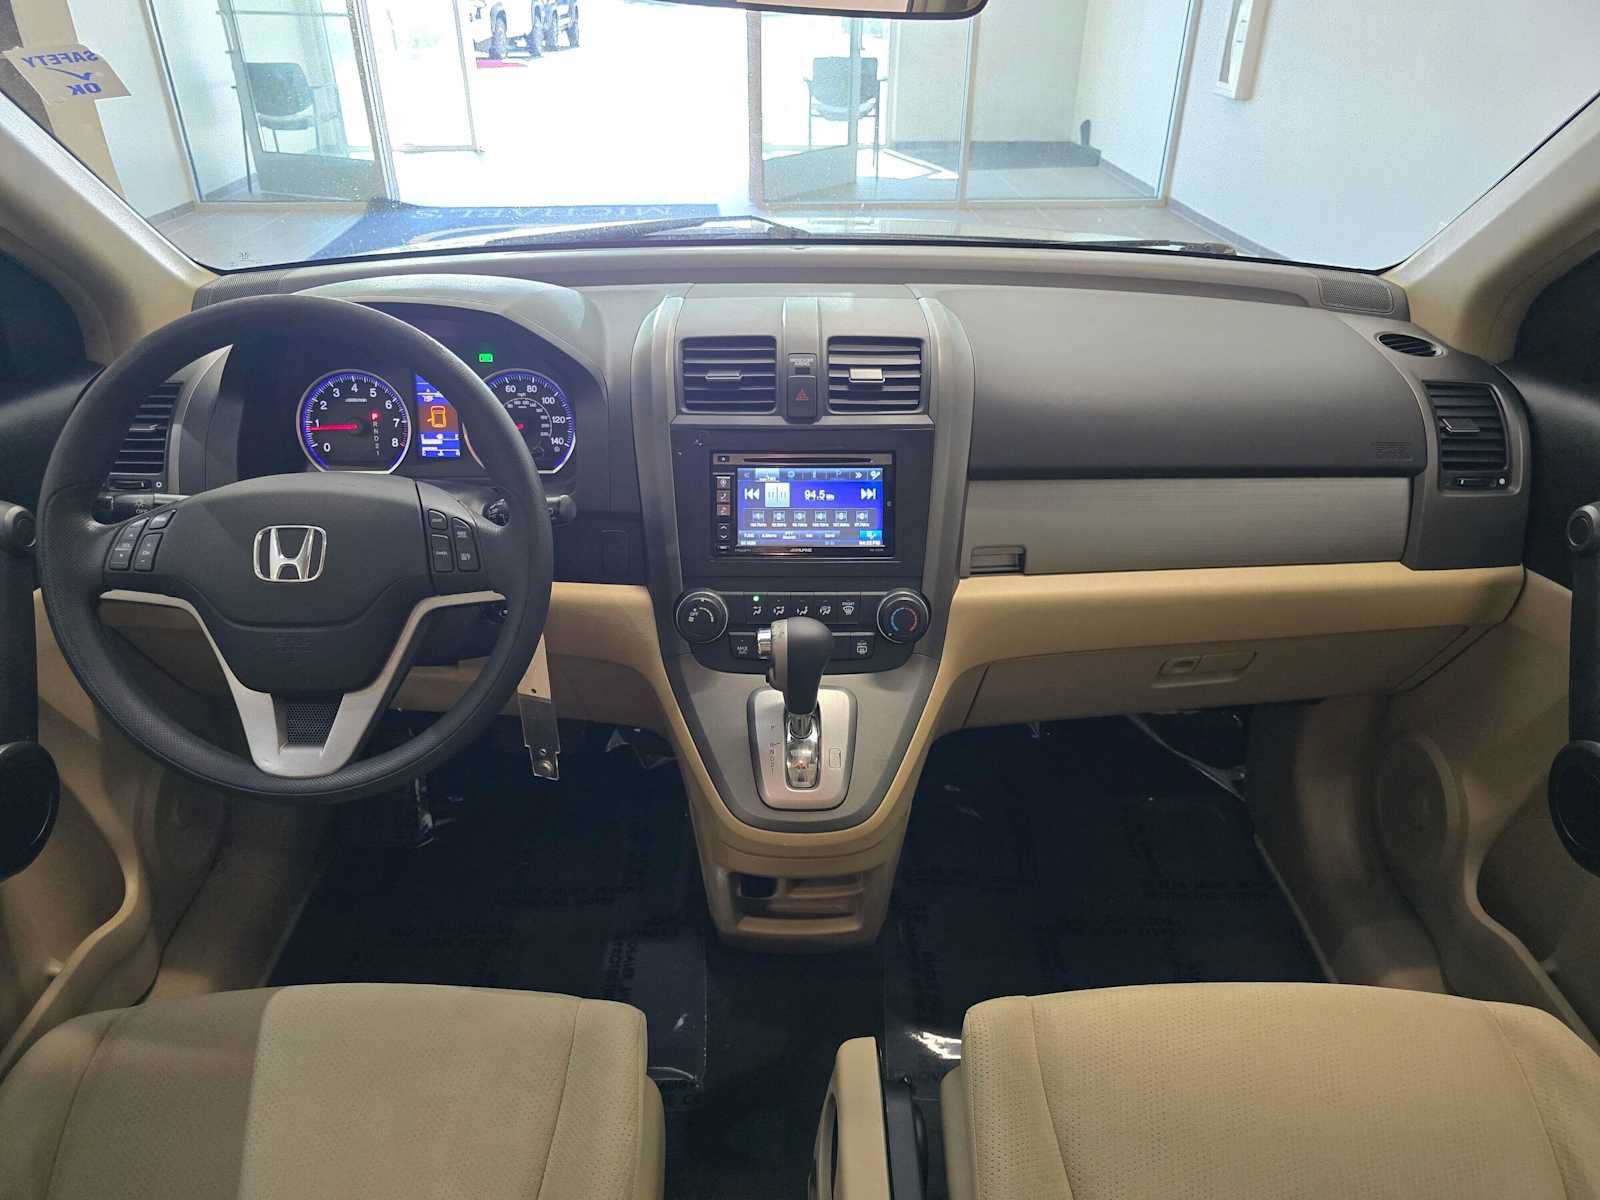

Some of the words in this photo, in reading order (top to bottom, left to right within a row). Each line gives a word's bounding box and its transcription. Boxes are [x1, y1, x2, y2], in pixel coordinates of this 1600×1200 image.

[333, 388, 341, 398] 3
[351, 383, 358, 393] 4
[369, 388, 377, 398] 5
[505, 385, 516, 393] 60
[526, 385, 538, 393] 80
[320, 400, 328, 410] 2
[385, 400, 393, 410] 6
[542, 396, 555, 405] 100
[393, 418, 400, 428] 7
[552, 416, 566, 424] 120
[391, 438, 399, 448] 8
[550, 437, 565, 446] 140
[323, 443, 331, 453] 0
[804, 489, 825, 501] 94.5
